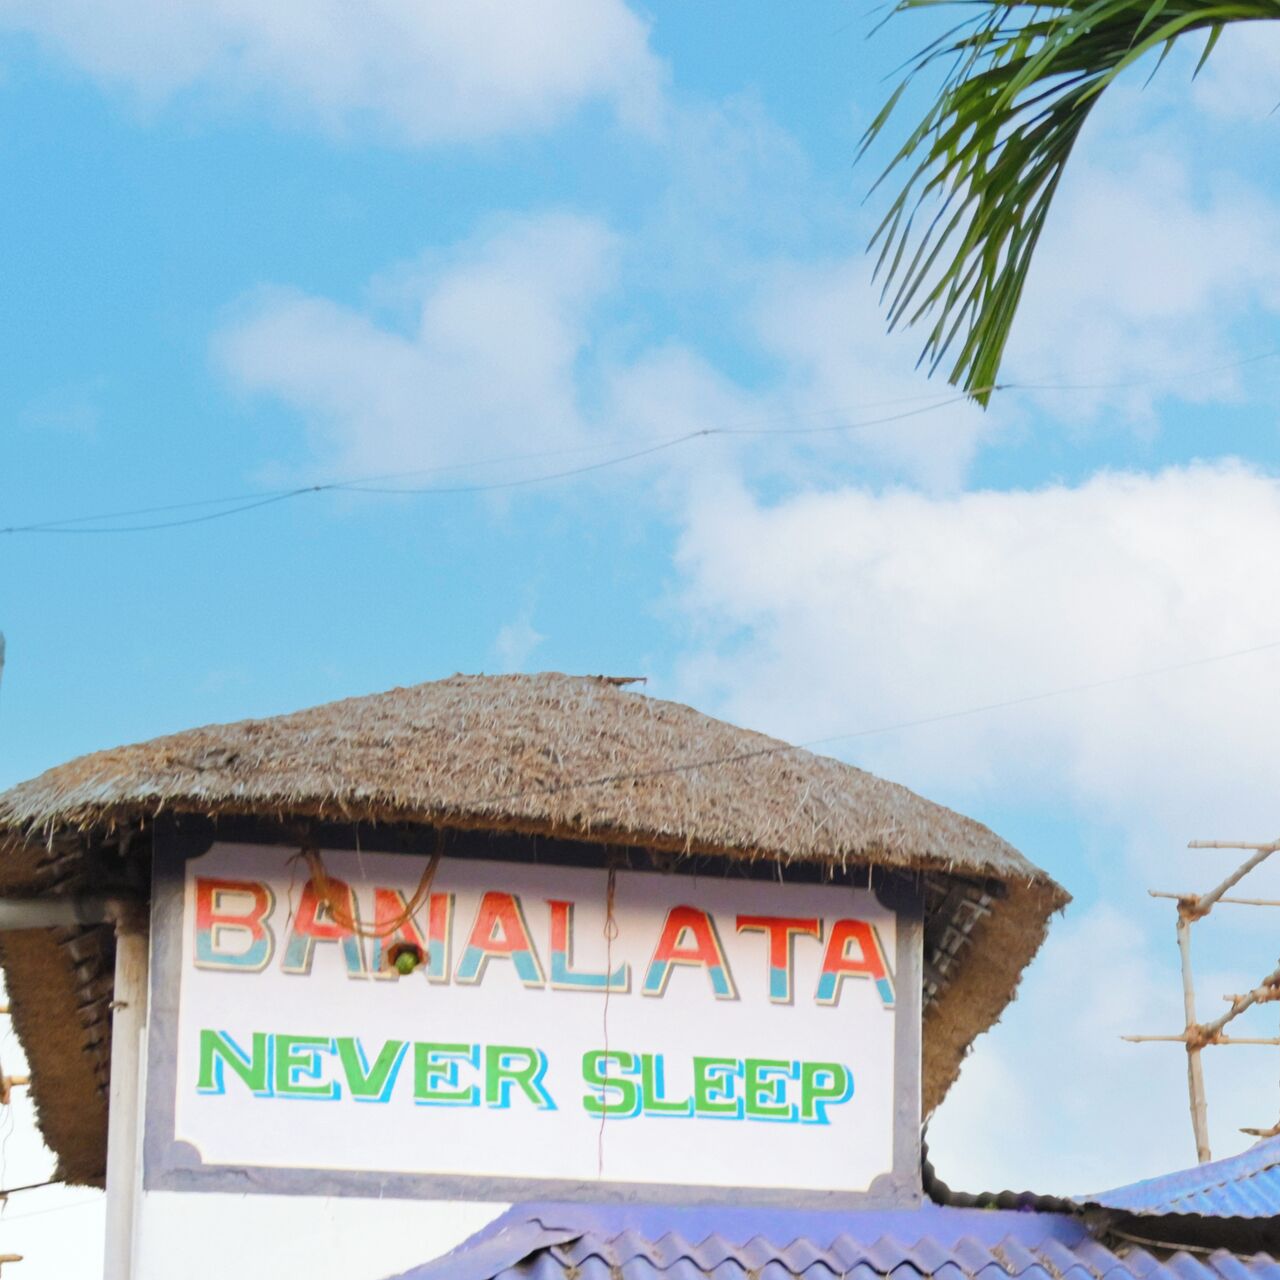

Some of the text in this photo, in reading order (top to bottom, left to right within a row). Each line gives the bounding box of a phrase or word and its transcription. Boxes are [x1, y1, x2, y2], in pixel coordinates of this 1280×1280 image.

[193, 876, 897, 1008] BANALATA
[197, 1029, 855, 1126] NEVER SLEEP
